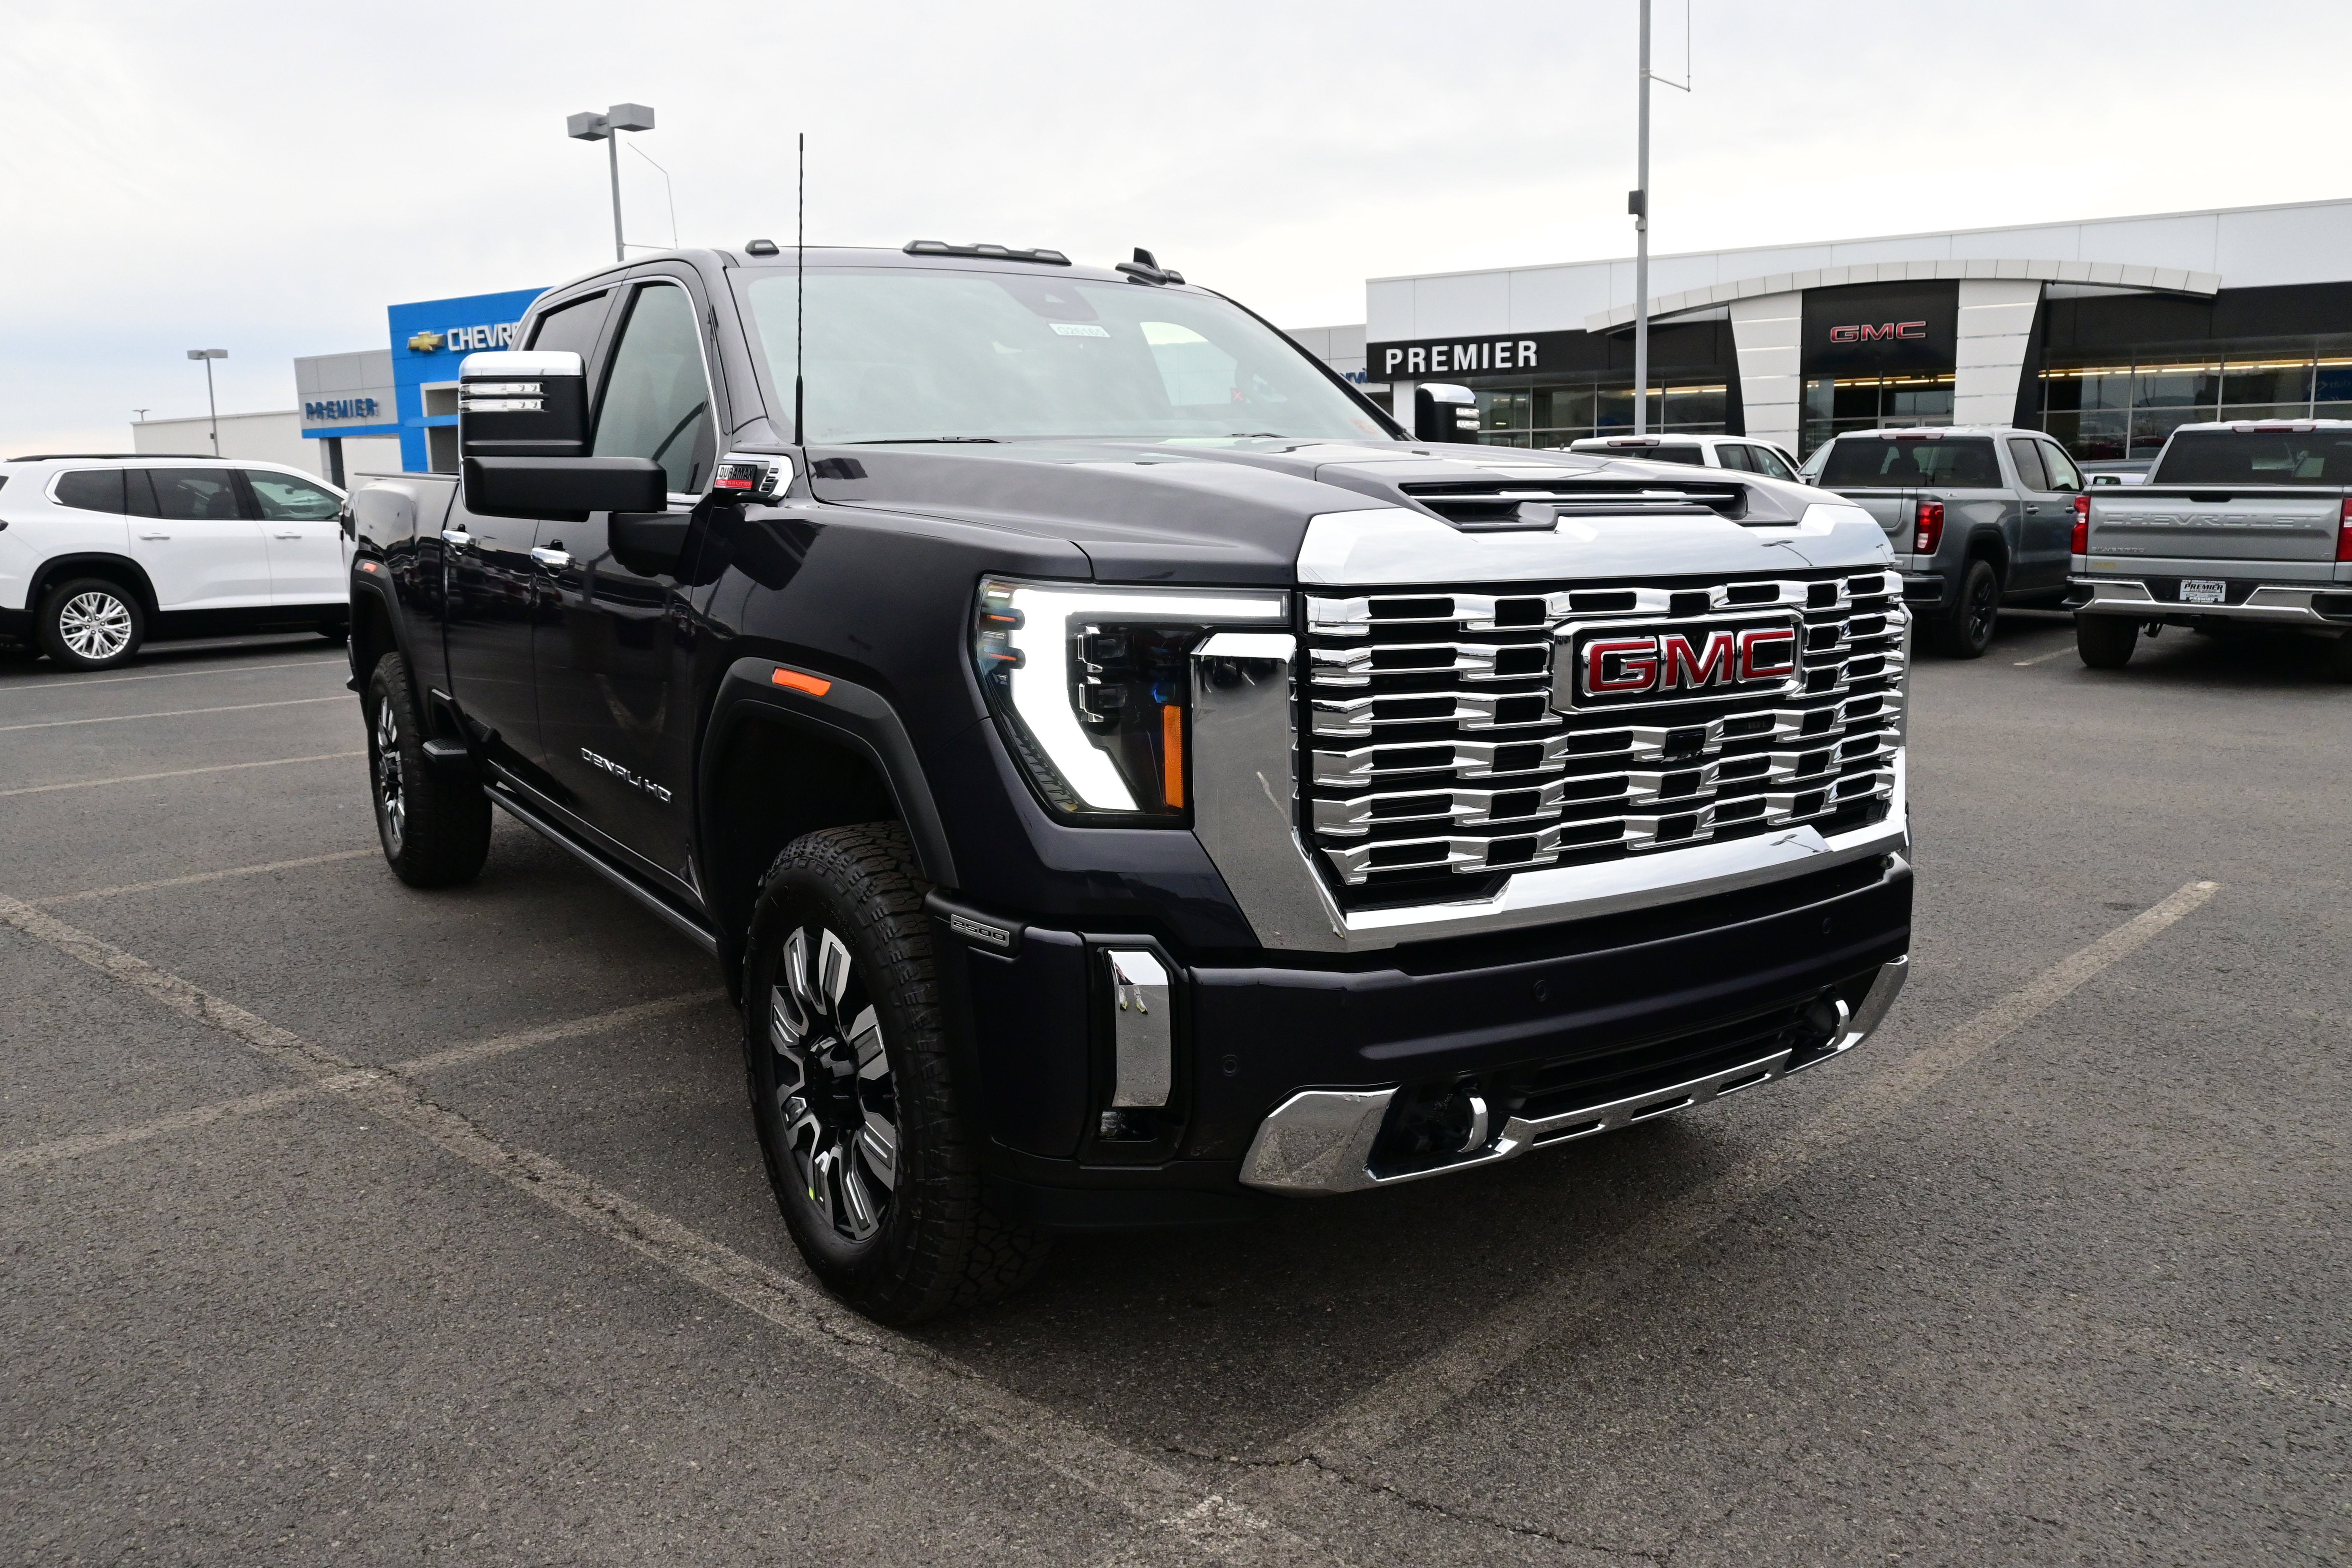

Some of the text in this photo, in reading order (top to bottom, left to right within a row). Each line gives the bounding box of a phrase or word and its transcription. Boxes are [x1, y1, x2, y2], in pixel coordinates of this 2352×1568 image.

[1830, 321, 1926, 343] GMC
[1386, 340, 1538, 374] PREMIER
[305, 398, 377, 420] PREMIER
[719, 467, 753, 479] DURAMAX
[2104, 513, 2321, 528] CHEVROLET
[2184, 582, 2223, 593] PREMIER
[1581, 625, 1795, 697] GMC
[581, 747, 673, 804] DENALI HD
[953, 920, 1006, 942] 2500
